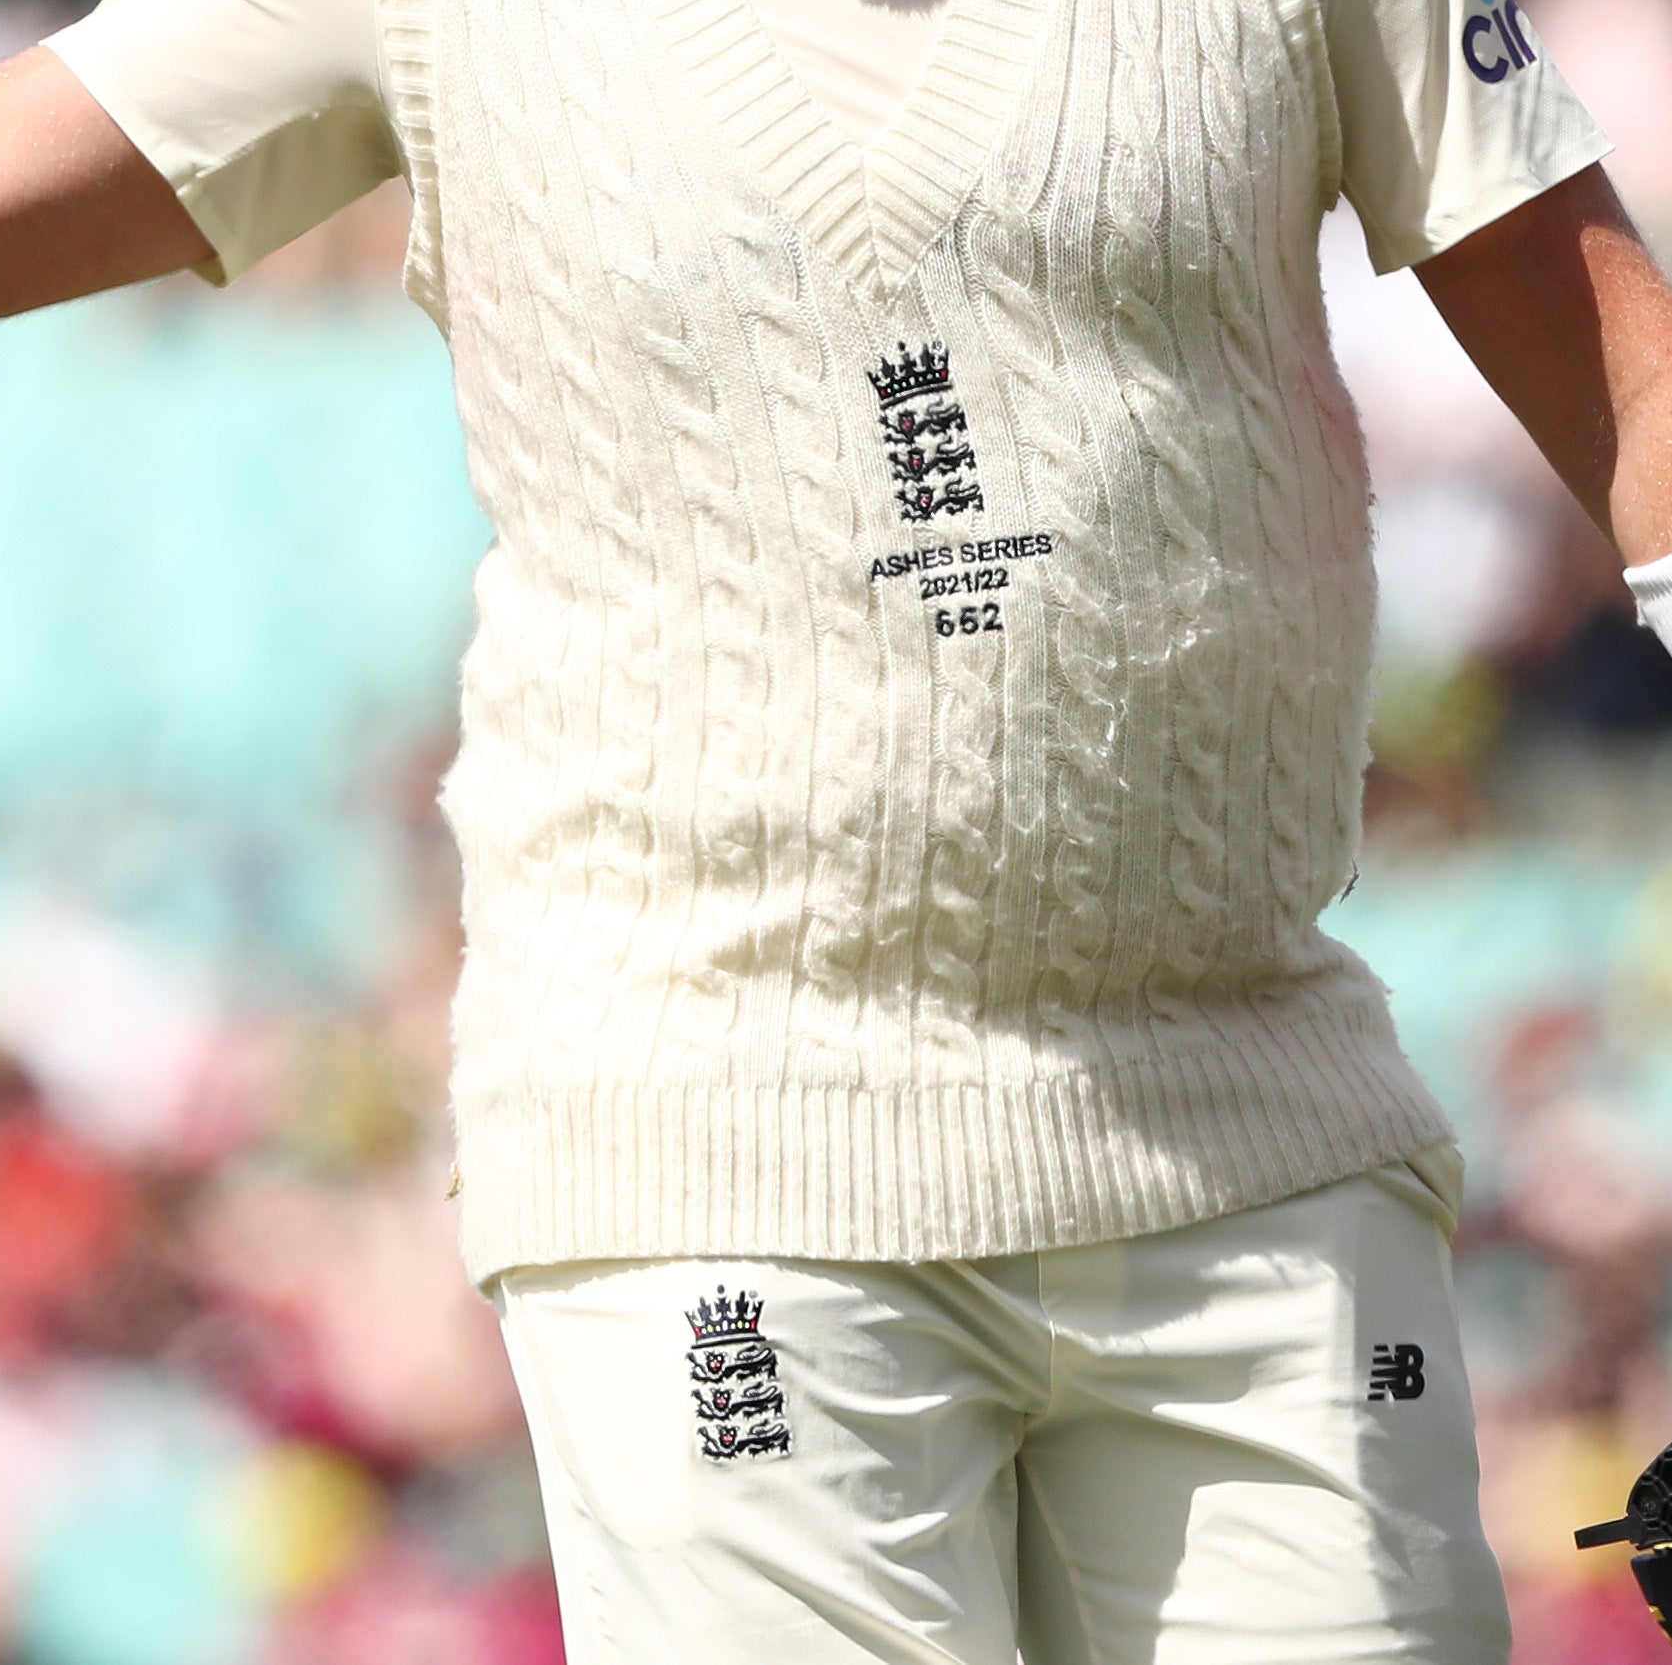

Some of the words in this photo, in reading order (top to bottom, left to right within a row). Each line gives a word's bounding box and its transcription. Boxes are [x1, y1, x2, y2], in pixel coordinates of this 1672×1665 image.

[870, 546, 954, 582] ASHES
[960, 534, 1053, 563] SERIES
[920, 568, 1008, 599] 2021/22
